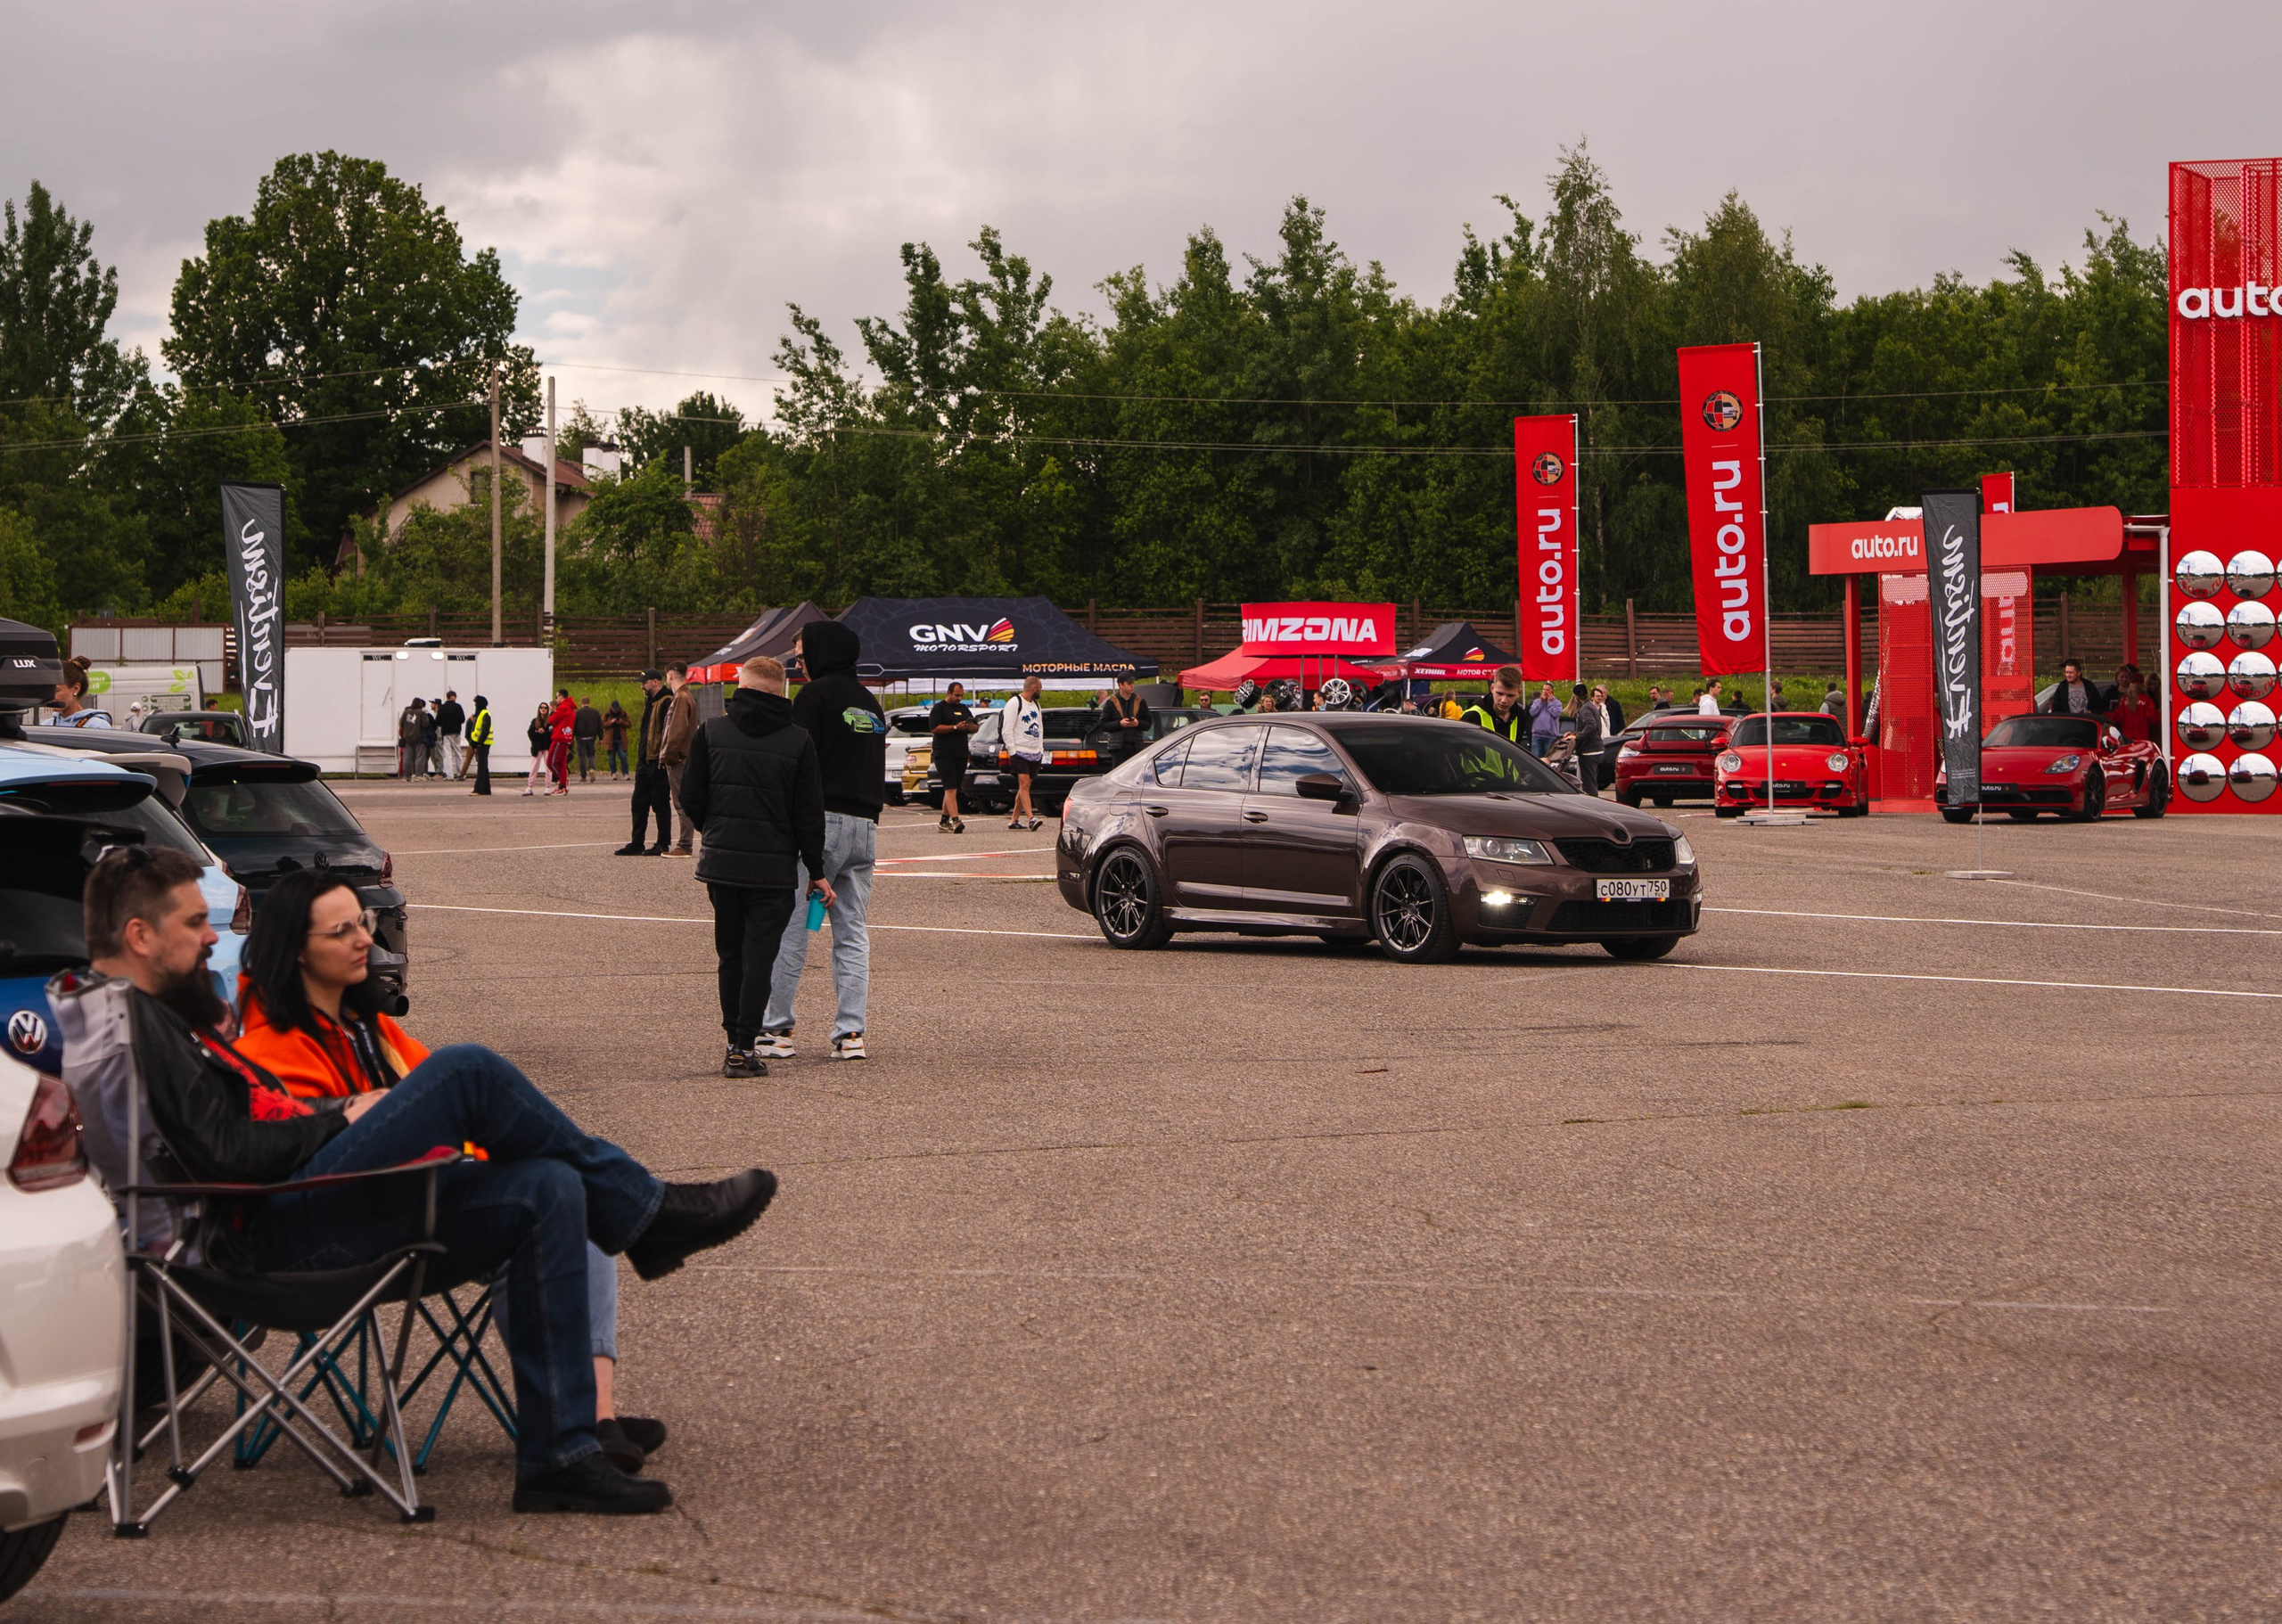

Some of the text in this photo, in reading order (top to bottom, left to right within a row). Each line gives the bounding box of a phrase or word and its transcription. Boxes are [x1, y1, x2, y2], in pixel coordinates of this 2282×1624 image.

[1712, 460, 1751, 642] auto.ru
[1851, 534, 1918, 560] auto.ru
[1536, 508, 1565, 655] auto.ru
[908, 623, 989, 643] GNV
[913, 643, 1019, 652] MOTORSPORT
[12, 659, 37, 668] LUX
[1022, 663, 1090, 673] МОТОРНЫЕ
[1648, 881, 1667, 892] 750
